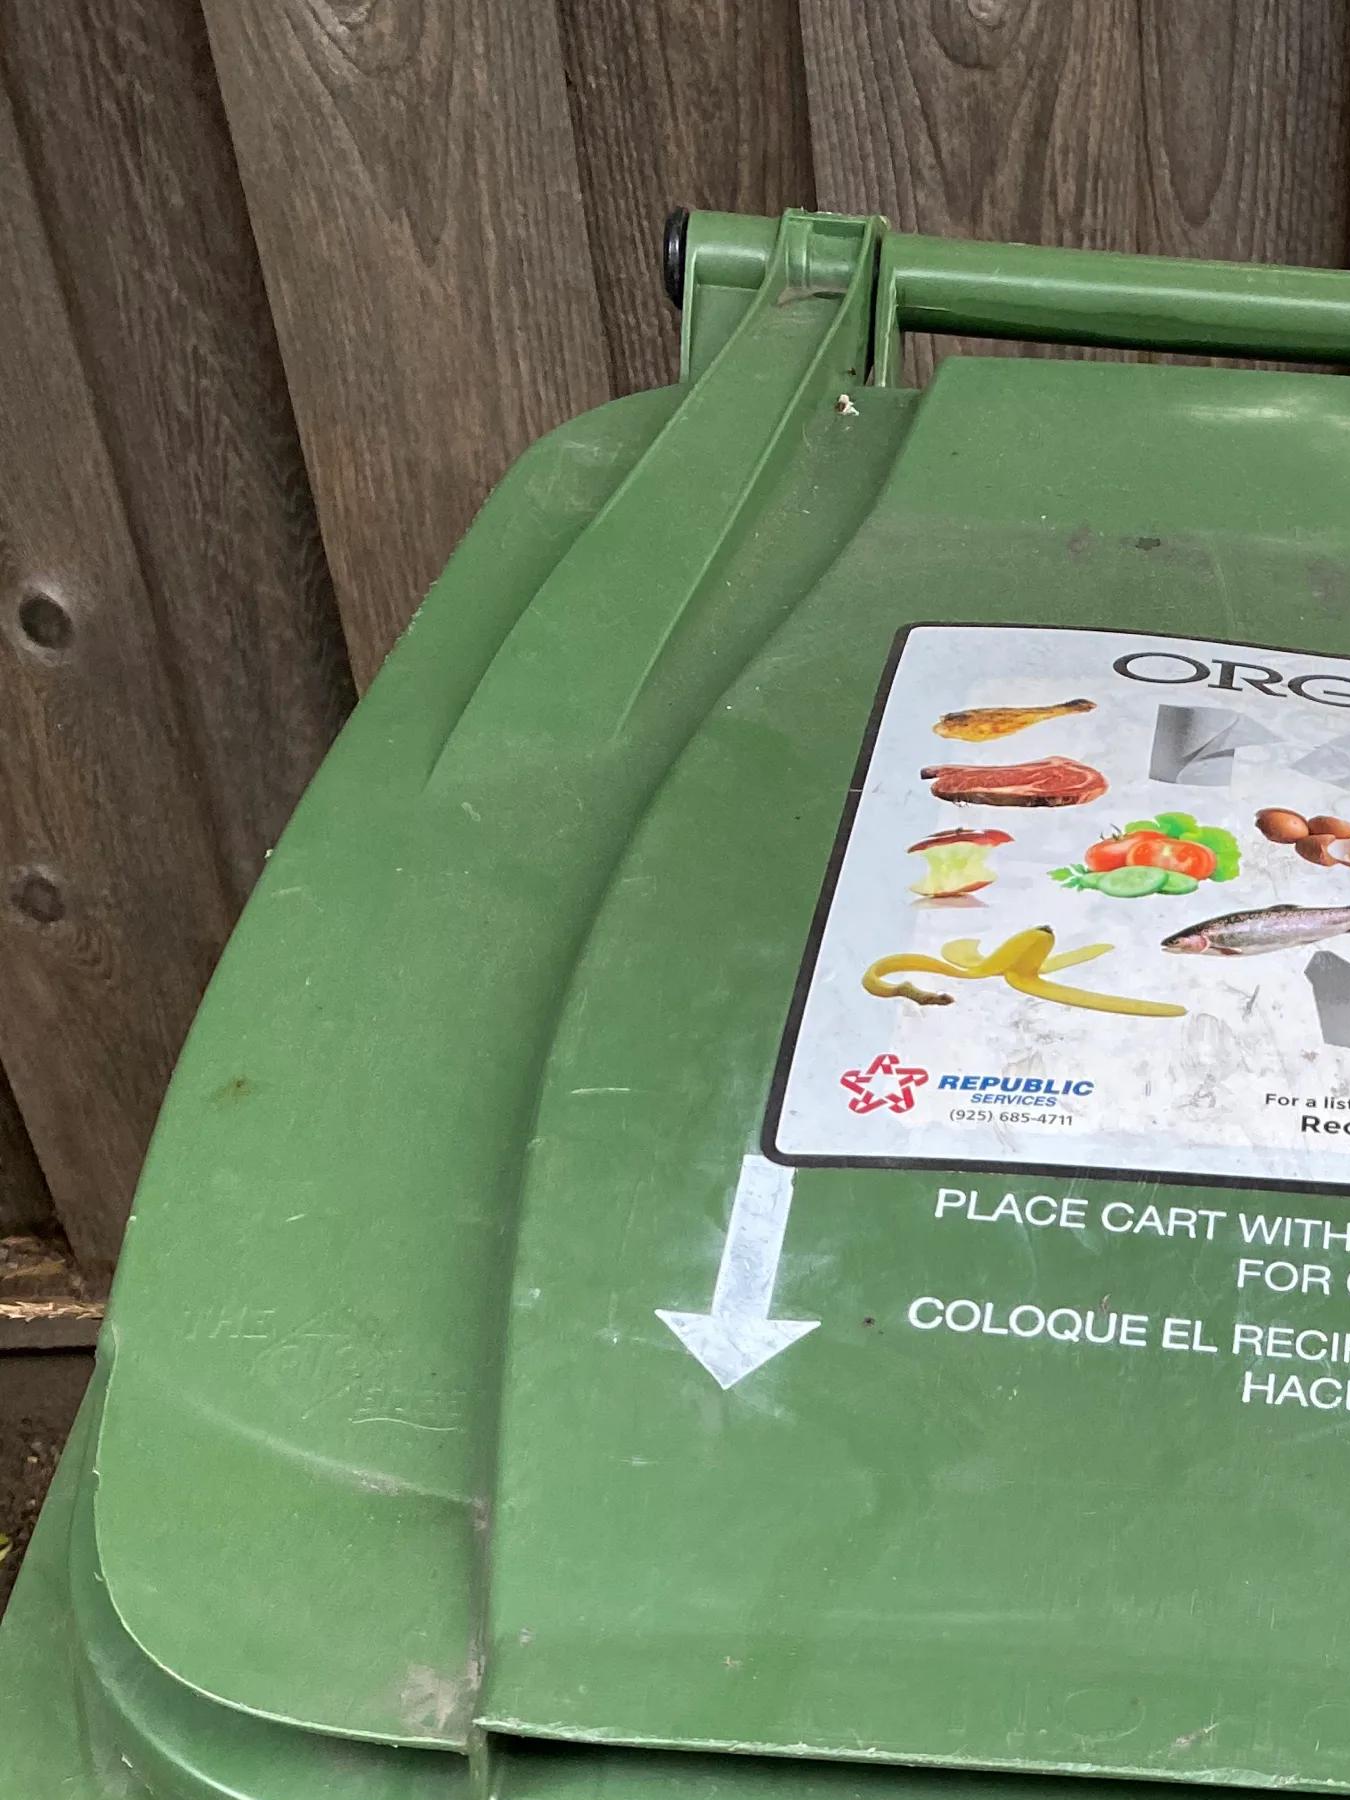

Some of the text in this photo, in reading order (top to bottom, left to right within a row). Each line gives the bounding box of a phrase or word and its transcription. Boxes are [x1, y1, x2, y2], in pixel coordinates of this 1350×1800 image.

[938, 1075, 1094, 1096] REPUBLIC
[970, 1093, 1057, 1107] SERVICES
[1265, 1093, 1299, 1107] For
[1305, 1098, 1317, 1109] a
[949, 1109, 1073, 1127] (925) 685-4711
[935, 1188, 1089, 1229] PLACE
[1101, 1202, 1226, 1240] CART
[1237, 1258, 1331, 1296] FOR
[908, 1296, 1148, 1347] COLOQUE
[1162, 1318, 1218, 1353] EL
